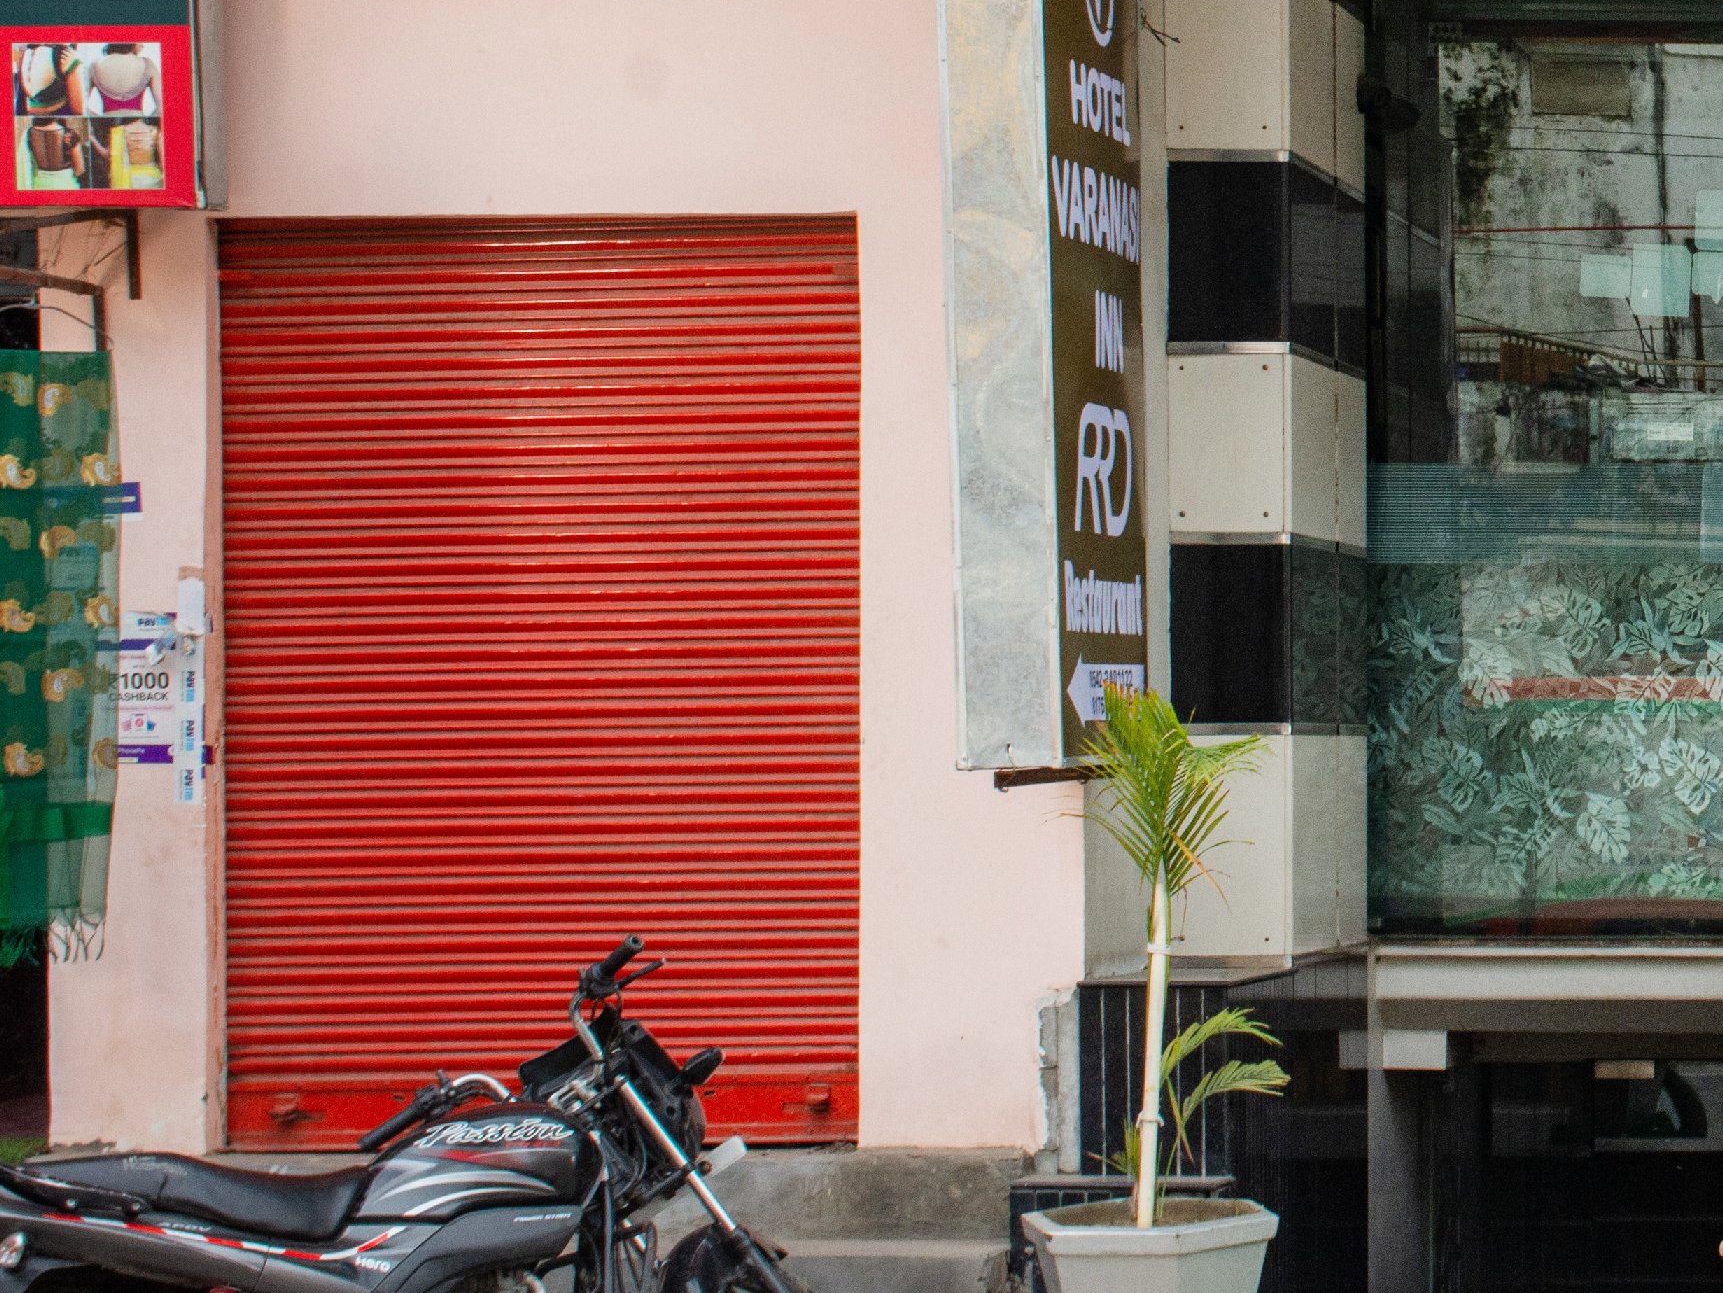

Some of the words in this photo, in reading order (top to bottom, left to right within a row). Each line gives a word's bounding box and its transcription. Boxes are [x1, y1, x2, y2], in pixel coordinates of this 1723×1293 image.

[1070, 59, 1131, 147] HOTEL
[1094, 290, 1124, 373] INN
[1063, 560, 1143, 636] Restaurant
[412, 1118, 575, 1149] Passion
